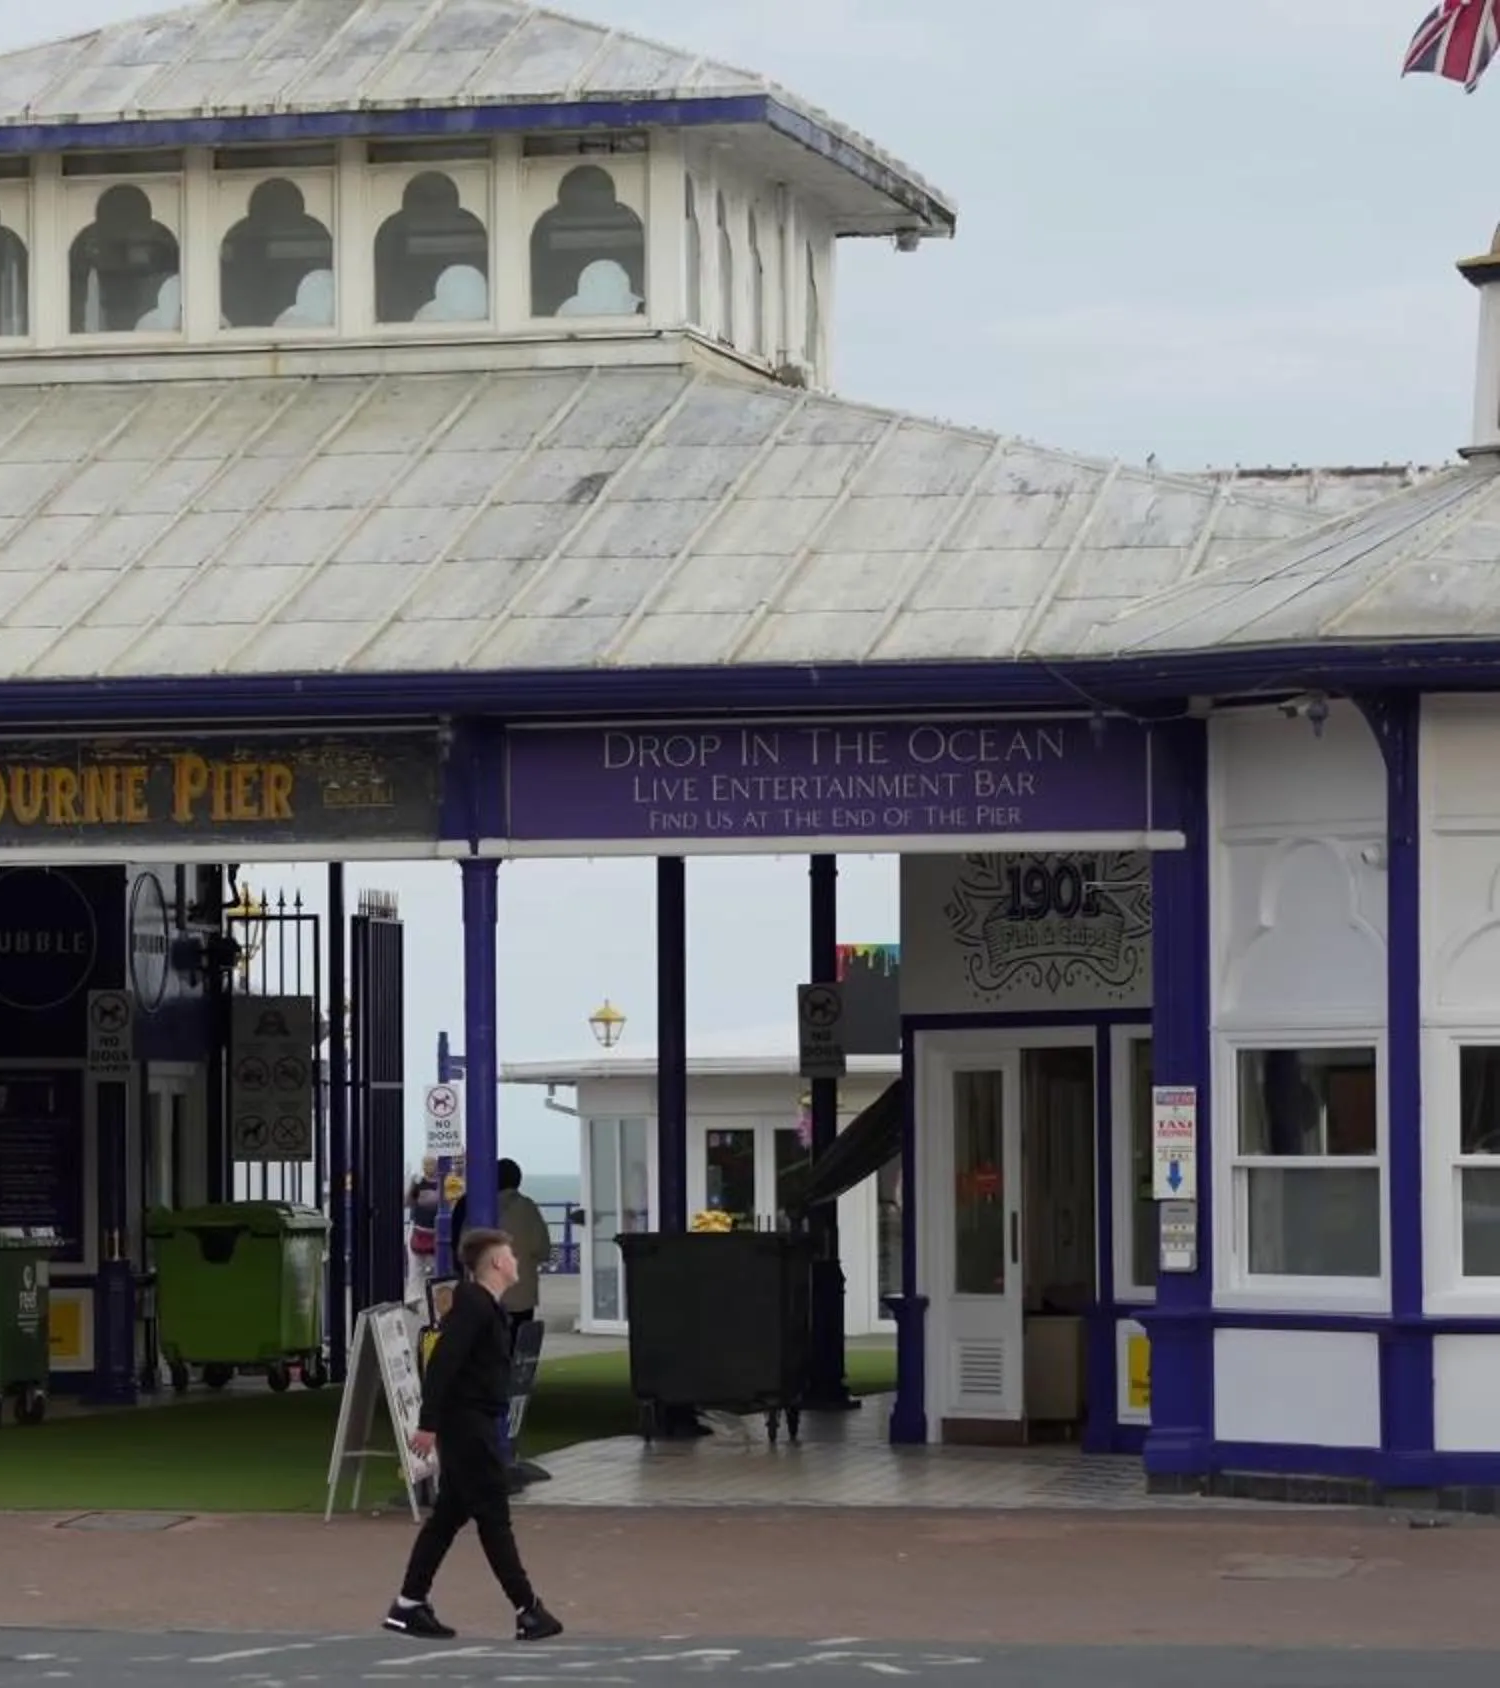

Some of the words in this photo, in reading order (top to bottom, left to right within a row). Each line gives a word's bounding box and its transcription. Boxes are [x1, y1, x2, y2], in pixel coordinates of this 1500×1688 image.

[604, 729, 721, 769] DROP
[741, 729, 779, 765] IN
[804, 729, 888, 764] THE
[908, 726, 1064, 763] OCEAN
[173, 753, 295, 822] PIER
[633, 775, 696, 803] LIVE
[712, 773, 959, 802] ENTERTAINMENT
[975, 771, 1036, 797] BAR
[649, 810, 697, 831] FIND
[706, 809, 733, 829] US
[742, 810, 767, 828] AT
[784, 808, 822, 829] THE
[832, 808, 876, 828] END
[883, 807, 913, 828] OF
[924, 806, 963, 827] THE
[976, 804, 1022, 826] PIER
[1006, 862, 1101, 921] 1901
[436, 1119, 451, 1129] NO
